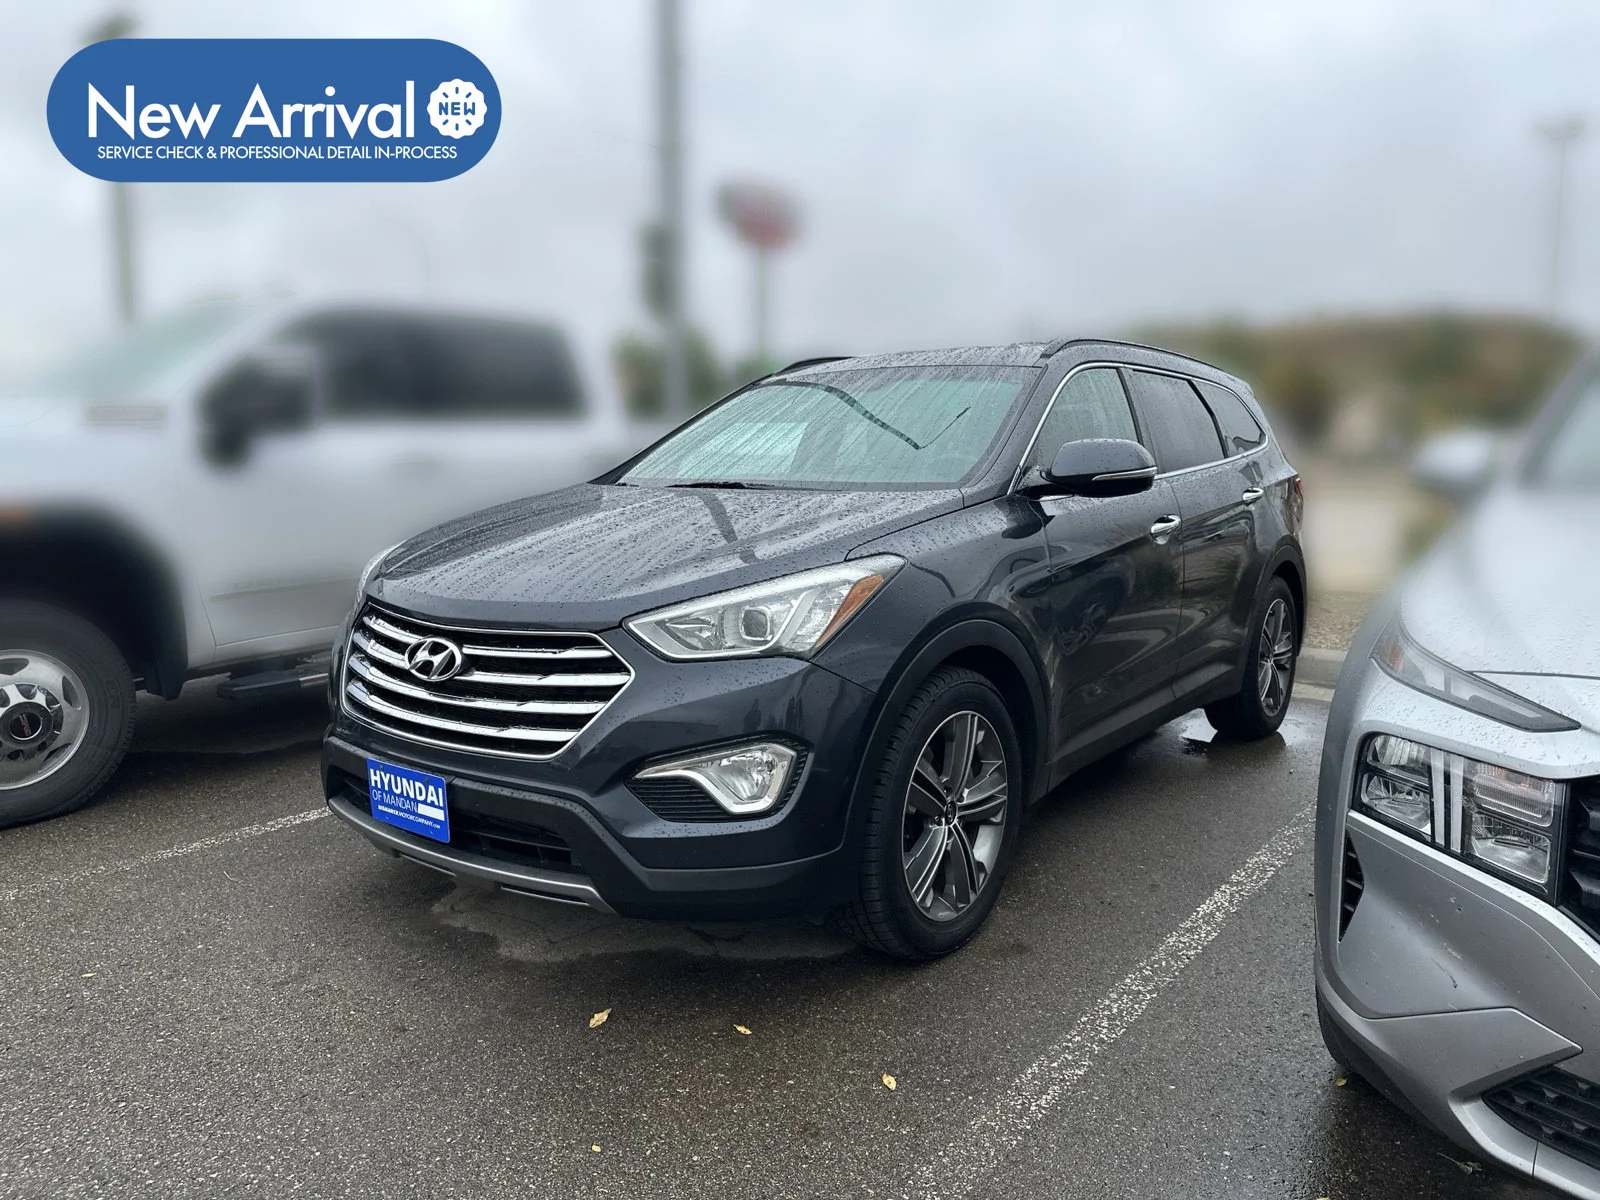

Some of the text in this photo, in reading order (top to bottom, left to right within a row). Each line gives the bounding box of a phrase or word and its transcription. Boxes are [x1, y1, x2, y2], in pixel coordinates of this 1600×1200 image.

[369, 768, 444, 808] HYUNDAI
[372, 789, 418, 813] OF MANDAN
